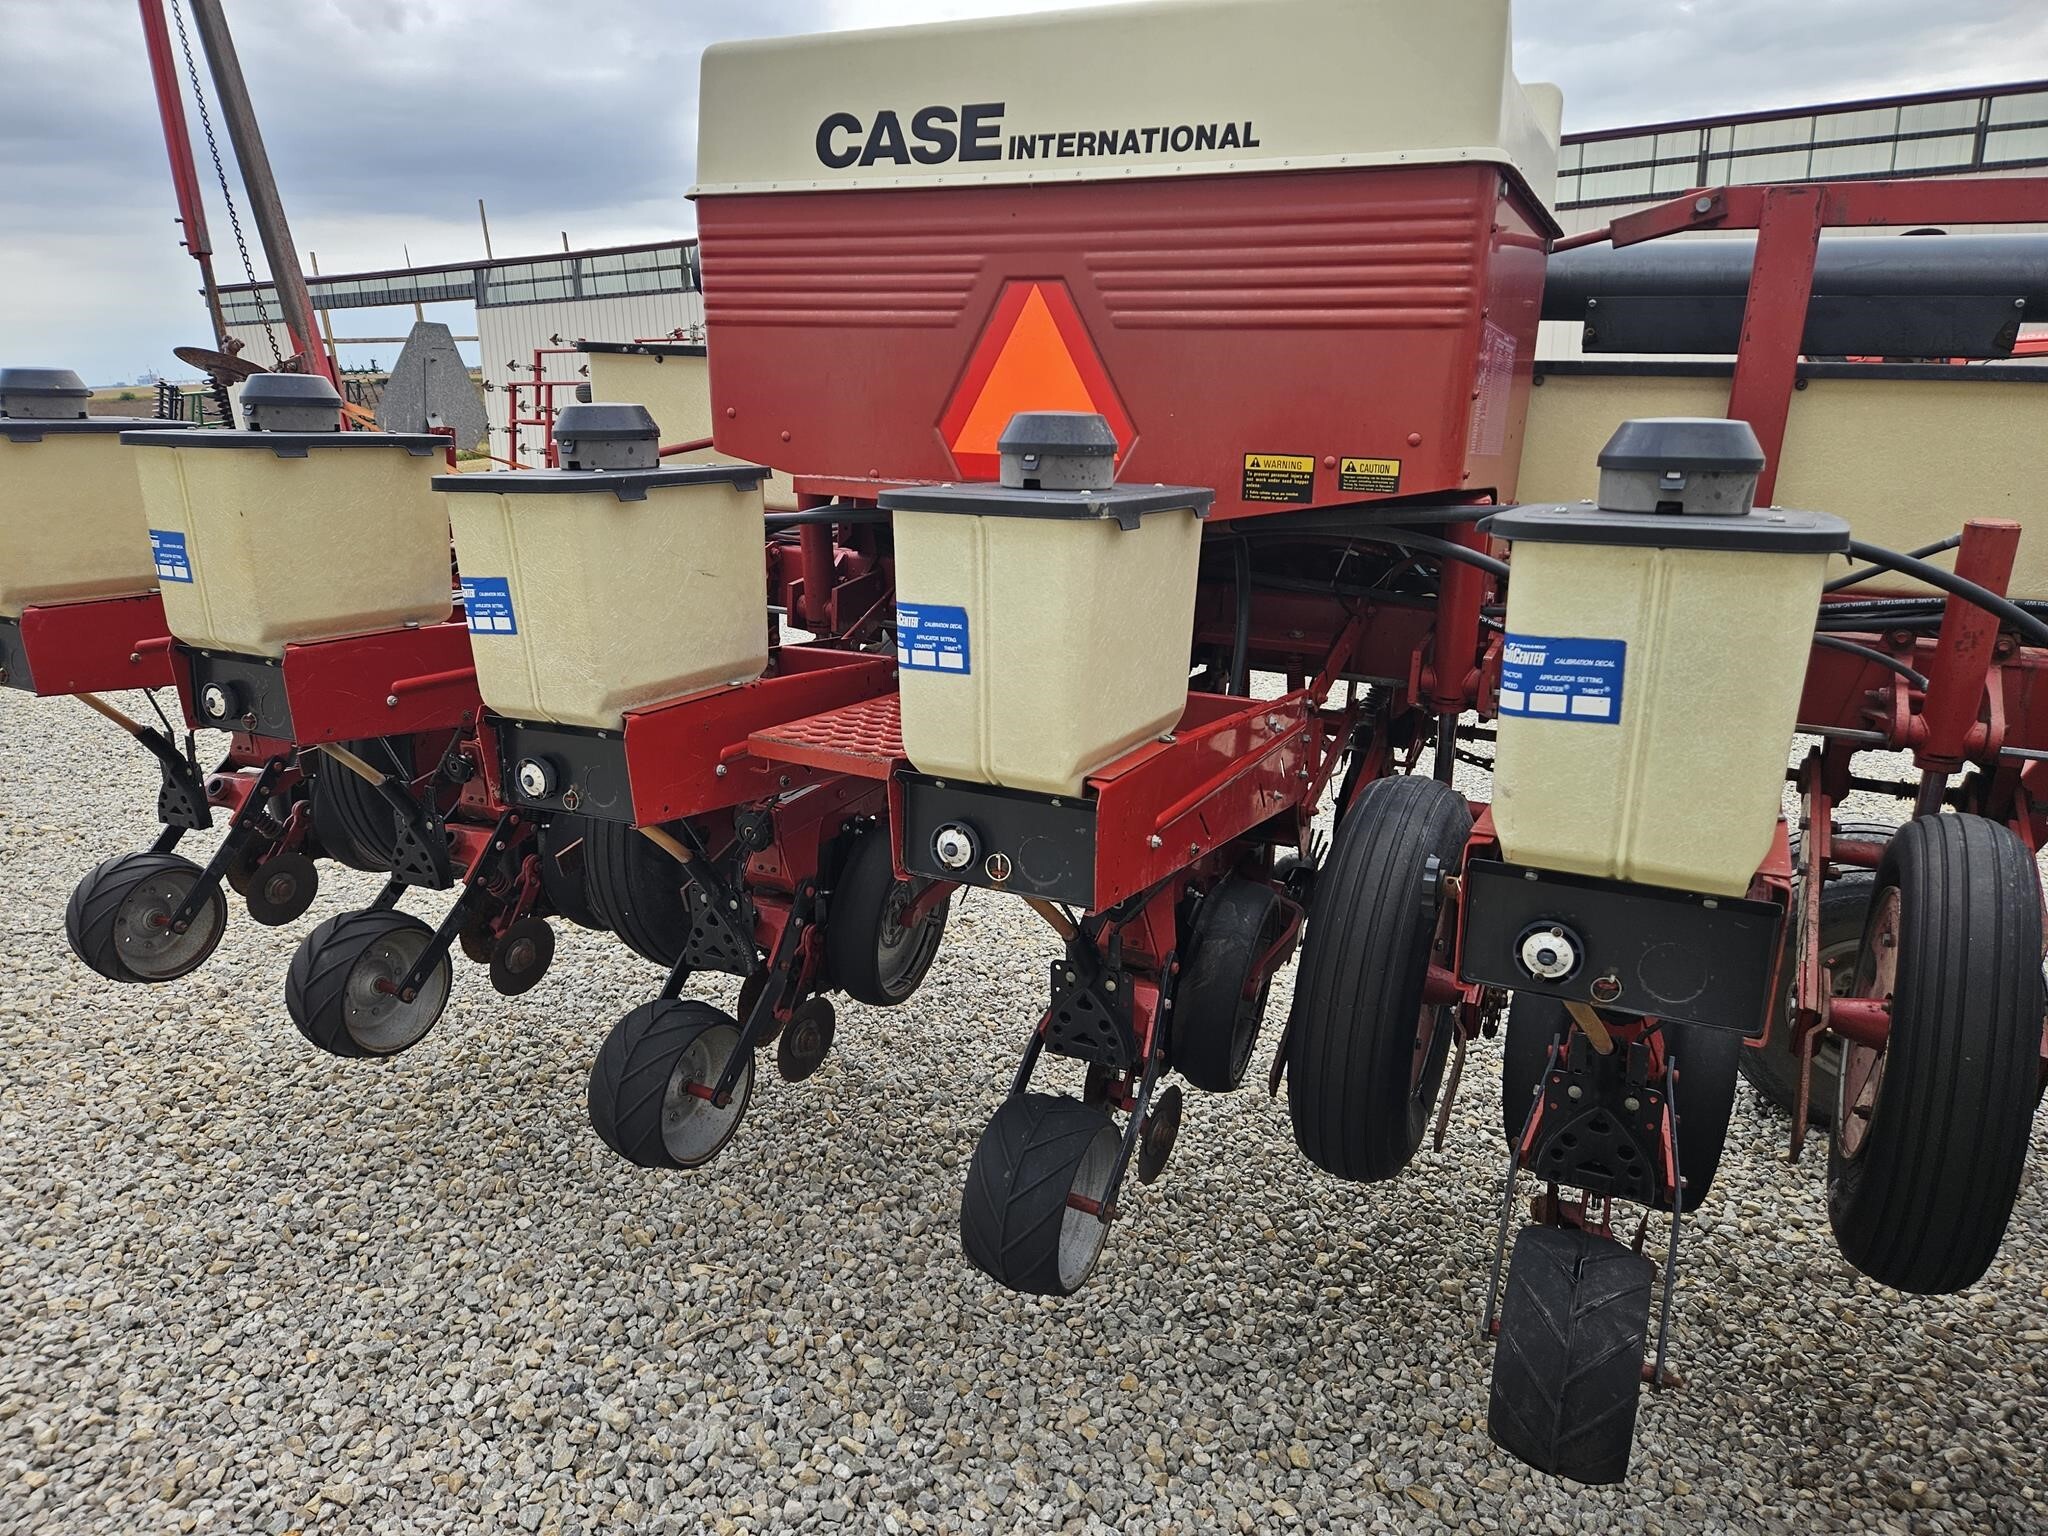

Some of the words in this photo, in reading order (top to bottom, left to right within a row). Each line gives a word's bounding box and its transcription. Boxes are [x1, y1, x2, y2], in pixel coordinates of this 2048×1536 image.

[815, 102, 1005, 168] CASE
[1008, 121, 1260, 161] INTERNATIONAL
[1263, 460, 1302, 470] WARNING
[1360, 464, 1391, 474] CAUTION
[1554, 658, 1594, 666] CALIBRATION
[1594, 660, 1615, 668] DECAL
[1539, 674, 1576, 682] APPLICATOR
